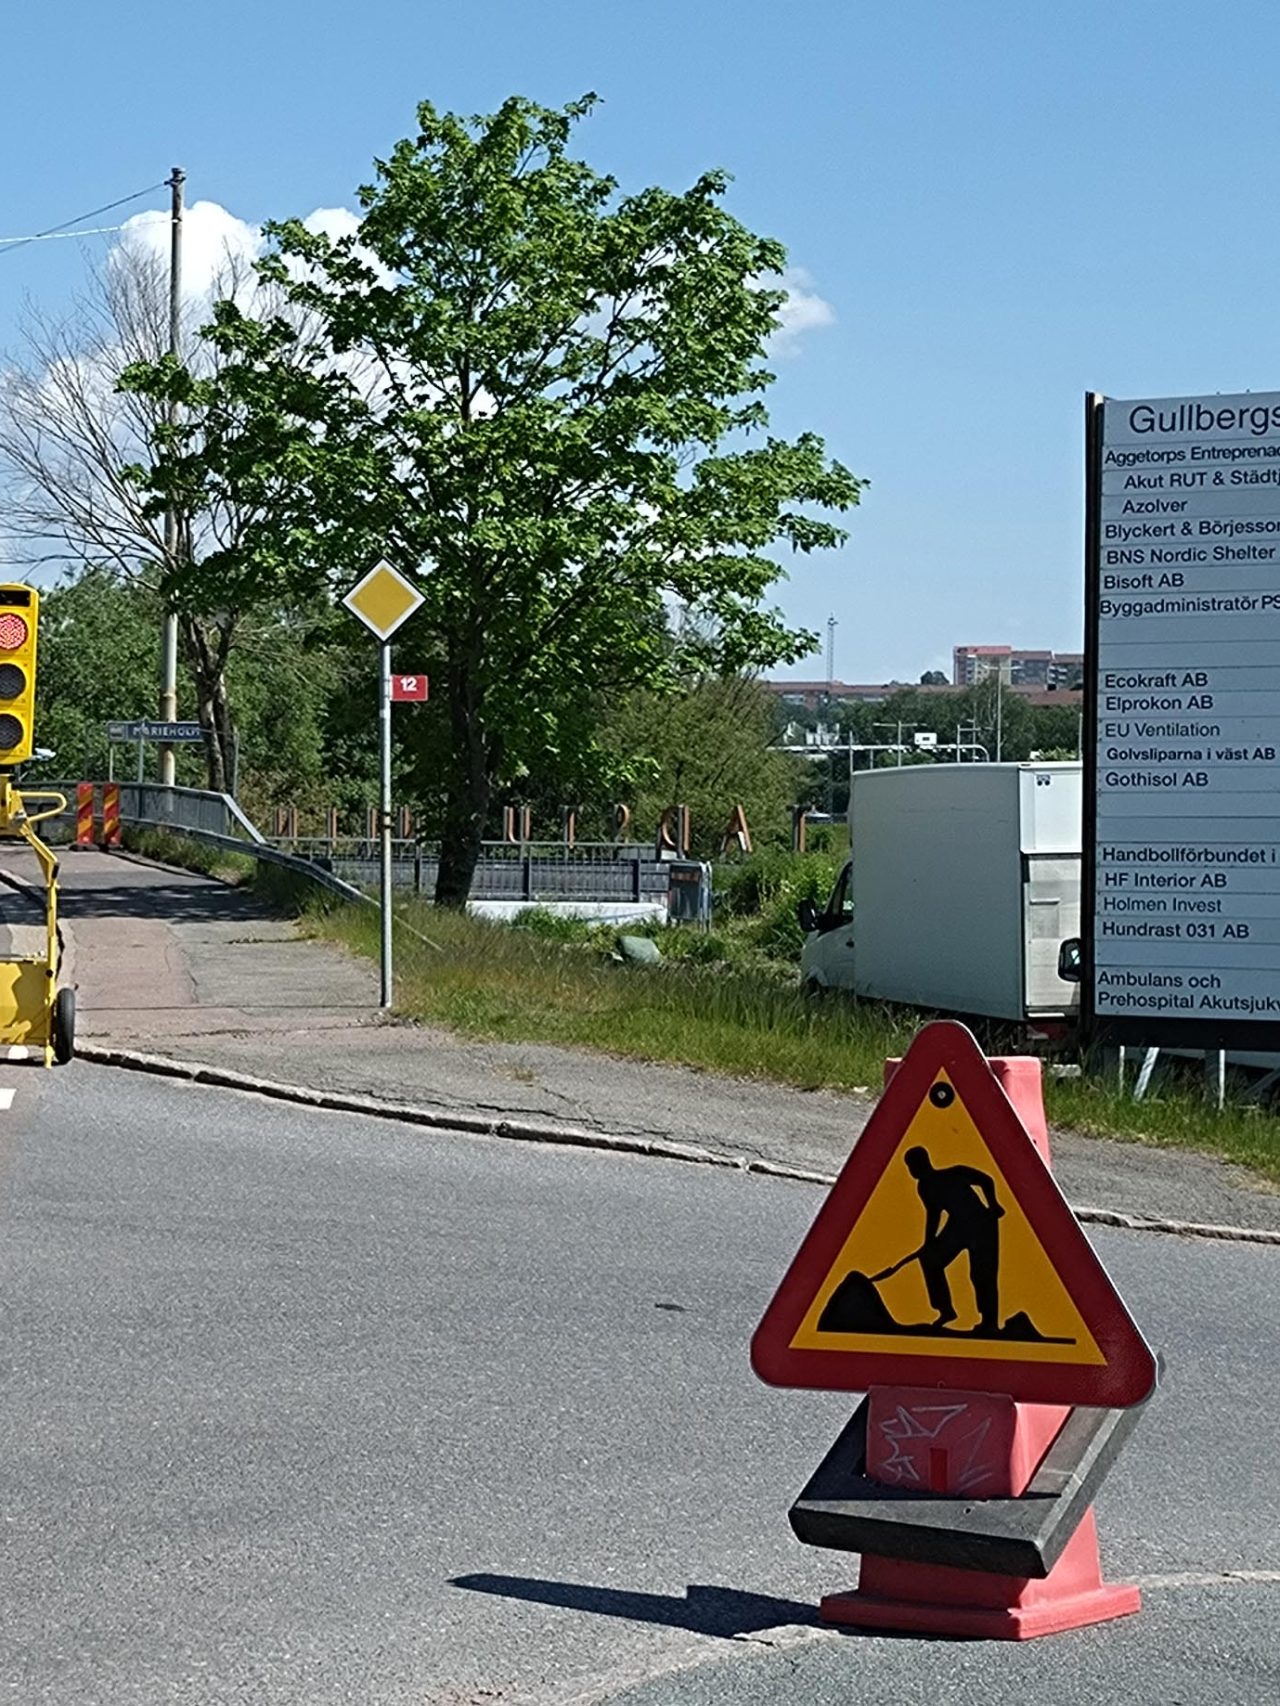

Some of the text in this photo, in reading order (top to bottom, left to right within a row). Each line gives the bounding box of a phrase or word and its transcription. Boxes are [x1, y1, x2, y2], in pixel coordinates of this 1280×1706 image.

[1105, 450, 1186, 467] Aggetorps
[1124, 475, 1164, 489] Akut
[1170, 472, 1207, 487] RUT
[1213, 471, 1225, 485] &
[1122, 499, 1188, 514] Azolver
[1106, 523, 1175, 541] Blyckert
[1181, 521, 1193, 536] &
[1107, 545, 1276, 564] BNS Nordic Shelter
[1105, 573, 1184, 589] Bisoft AB
[1100, 596, 1258, 617] Byggadministratör
[400, 678, 417, 691] 12
[1106, 672, 1208, 688] Ecokraft AB
[1106, 695, 1213, 713] Elprokon AB
[1106, 723, 1220, 737] EU Ventilation
[1107, 748, 1275, 763] Golvsliparna i väst AB
[1106, 772, 1208, 786] Gothisol AB
[1103, 848, 1275, 863] Handbollförbundet i
[1105, 873, 1227, 888] HF Interior AB
[1104, 897, 1221, 912] Holmen Invest
[1103, 922, 1249, 938] Hundrast 031 AB
[1099, 971, 1220, 988] Ambulans och
[1099, 992, 1194, 1010] Prehospital
